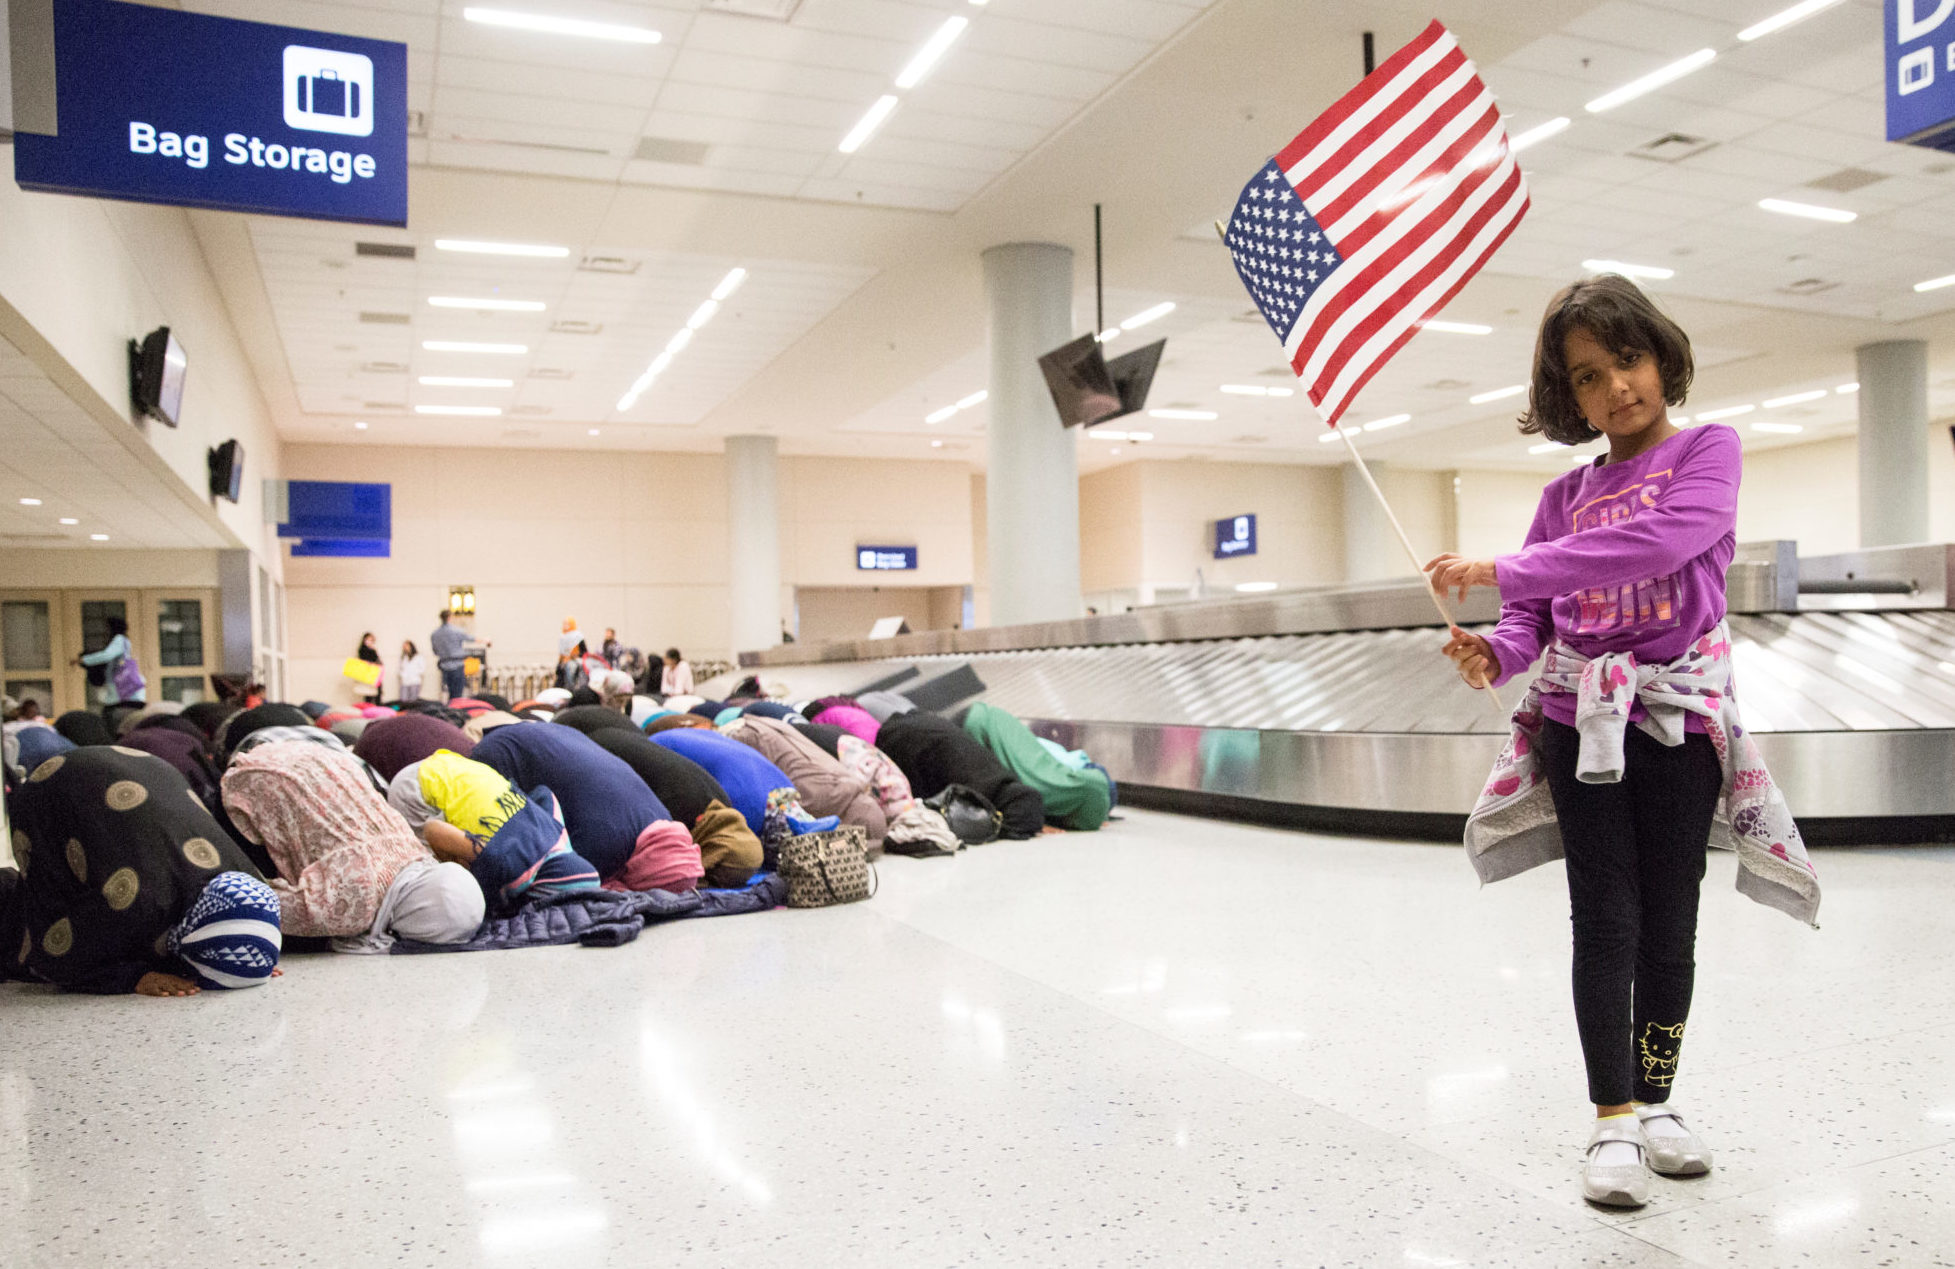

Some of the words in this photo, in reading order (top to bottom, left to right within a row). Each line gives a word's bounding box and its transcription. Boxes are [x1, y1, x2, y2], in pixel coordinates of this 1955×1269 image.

[129, 121, 209, 169] Bag
[224, 132, 377, 184] Storage
[1577, 576, 1672, 633] WIN
